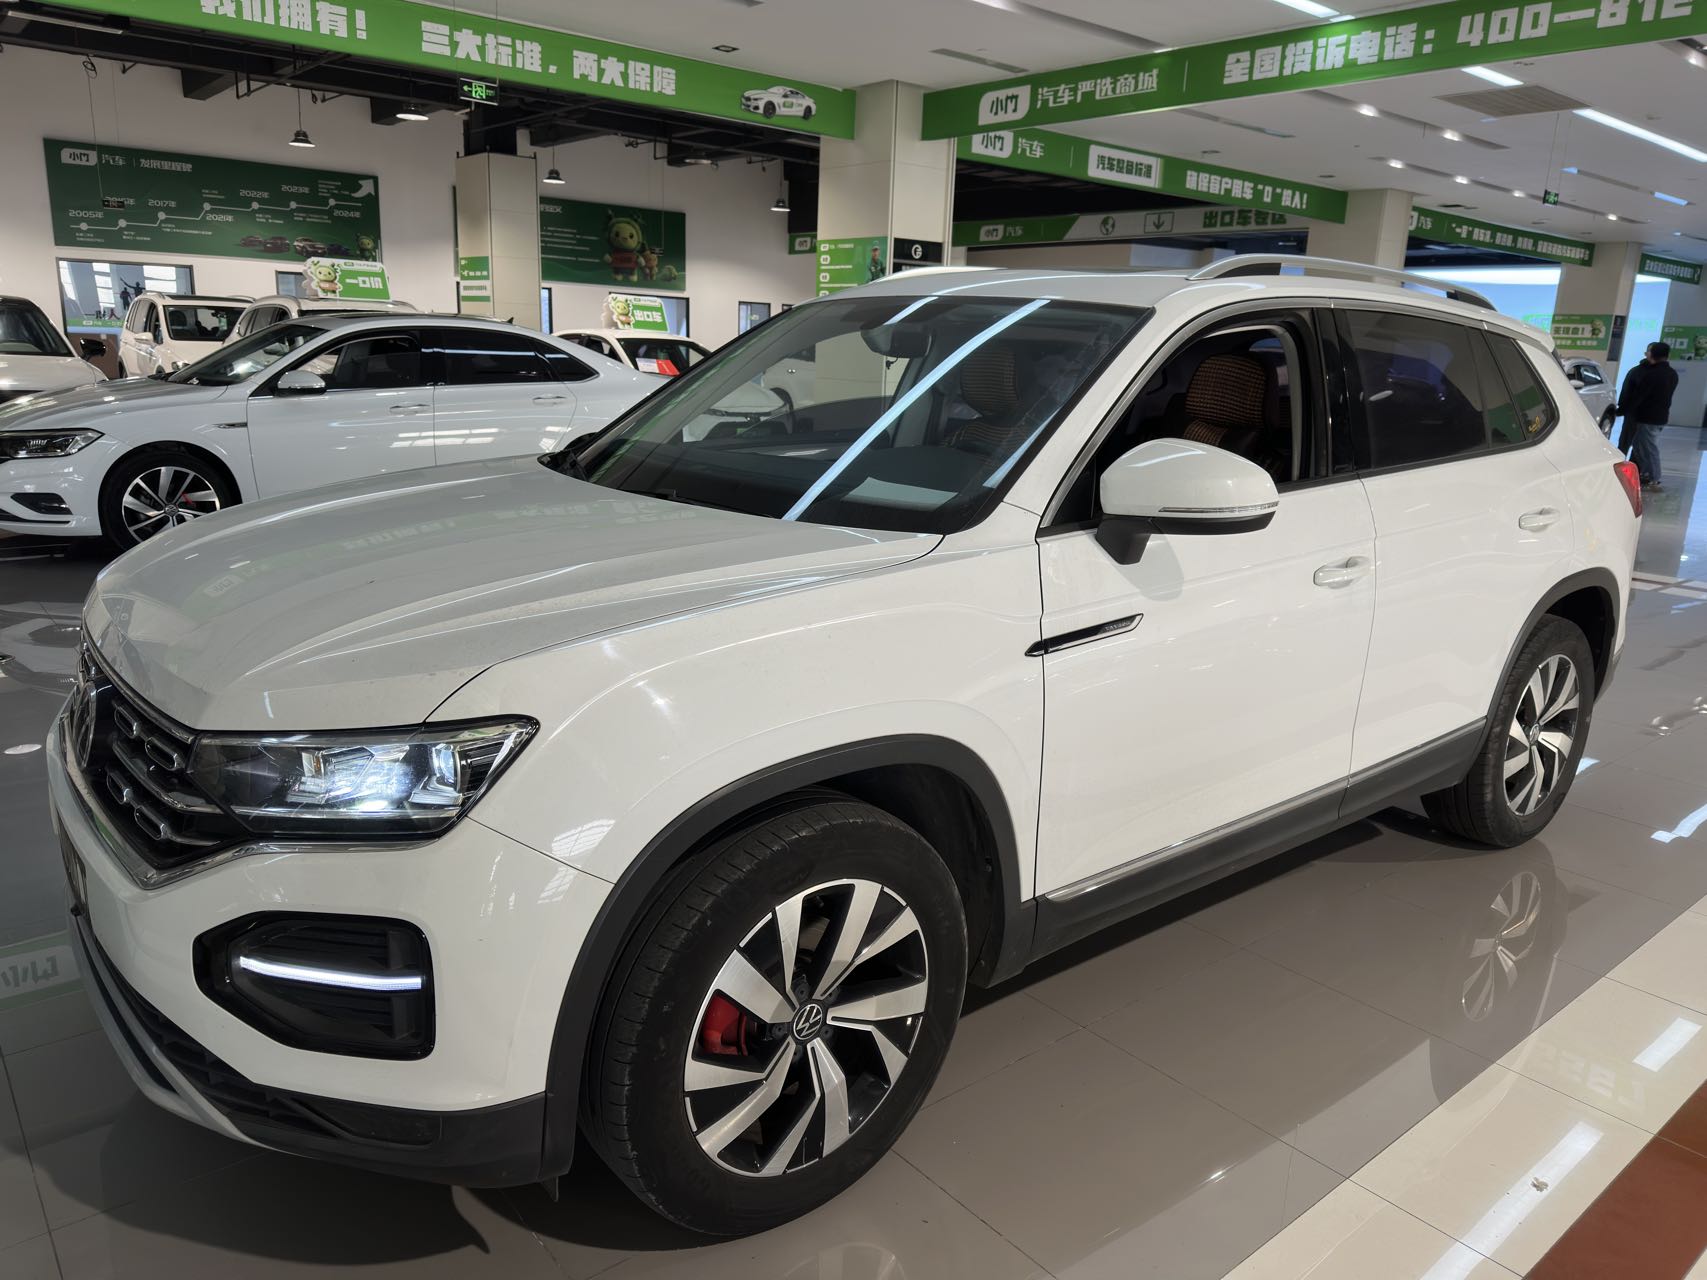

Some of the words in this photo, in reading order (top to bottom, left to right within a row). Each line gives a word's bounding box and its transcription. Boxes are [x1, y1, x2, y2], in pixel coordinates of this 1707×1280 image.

[989, 93, 1019, 117] 小竹
[1036, 68, 1159, 109] 汽车严选商城
[1223, 23, 1436, 85] 全国投诉电话：
[1017, 137, 1045, 158] 汽车
